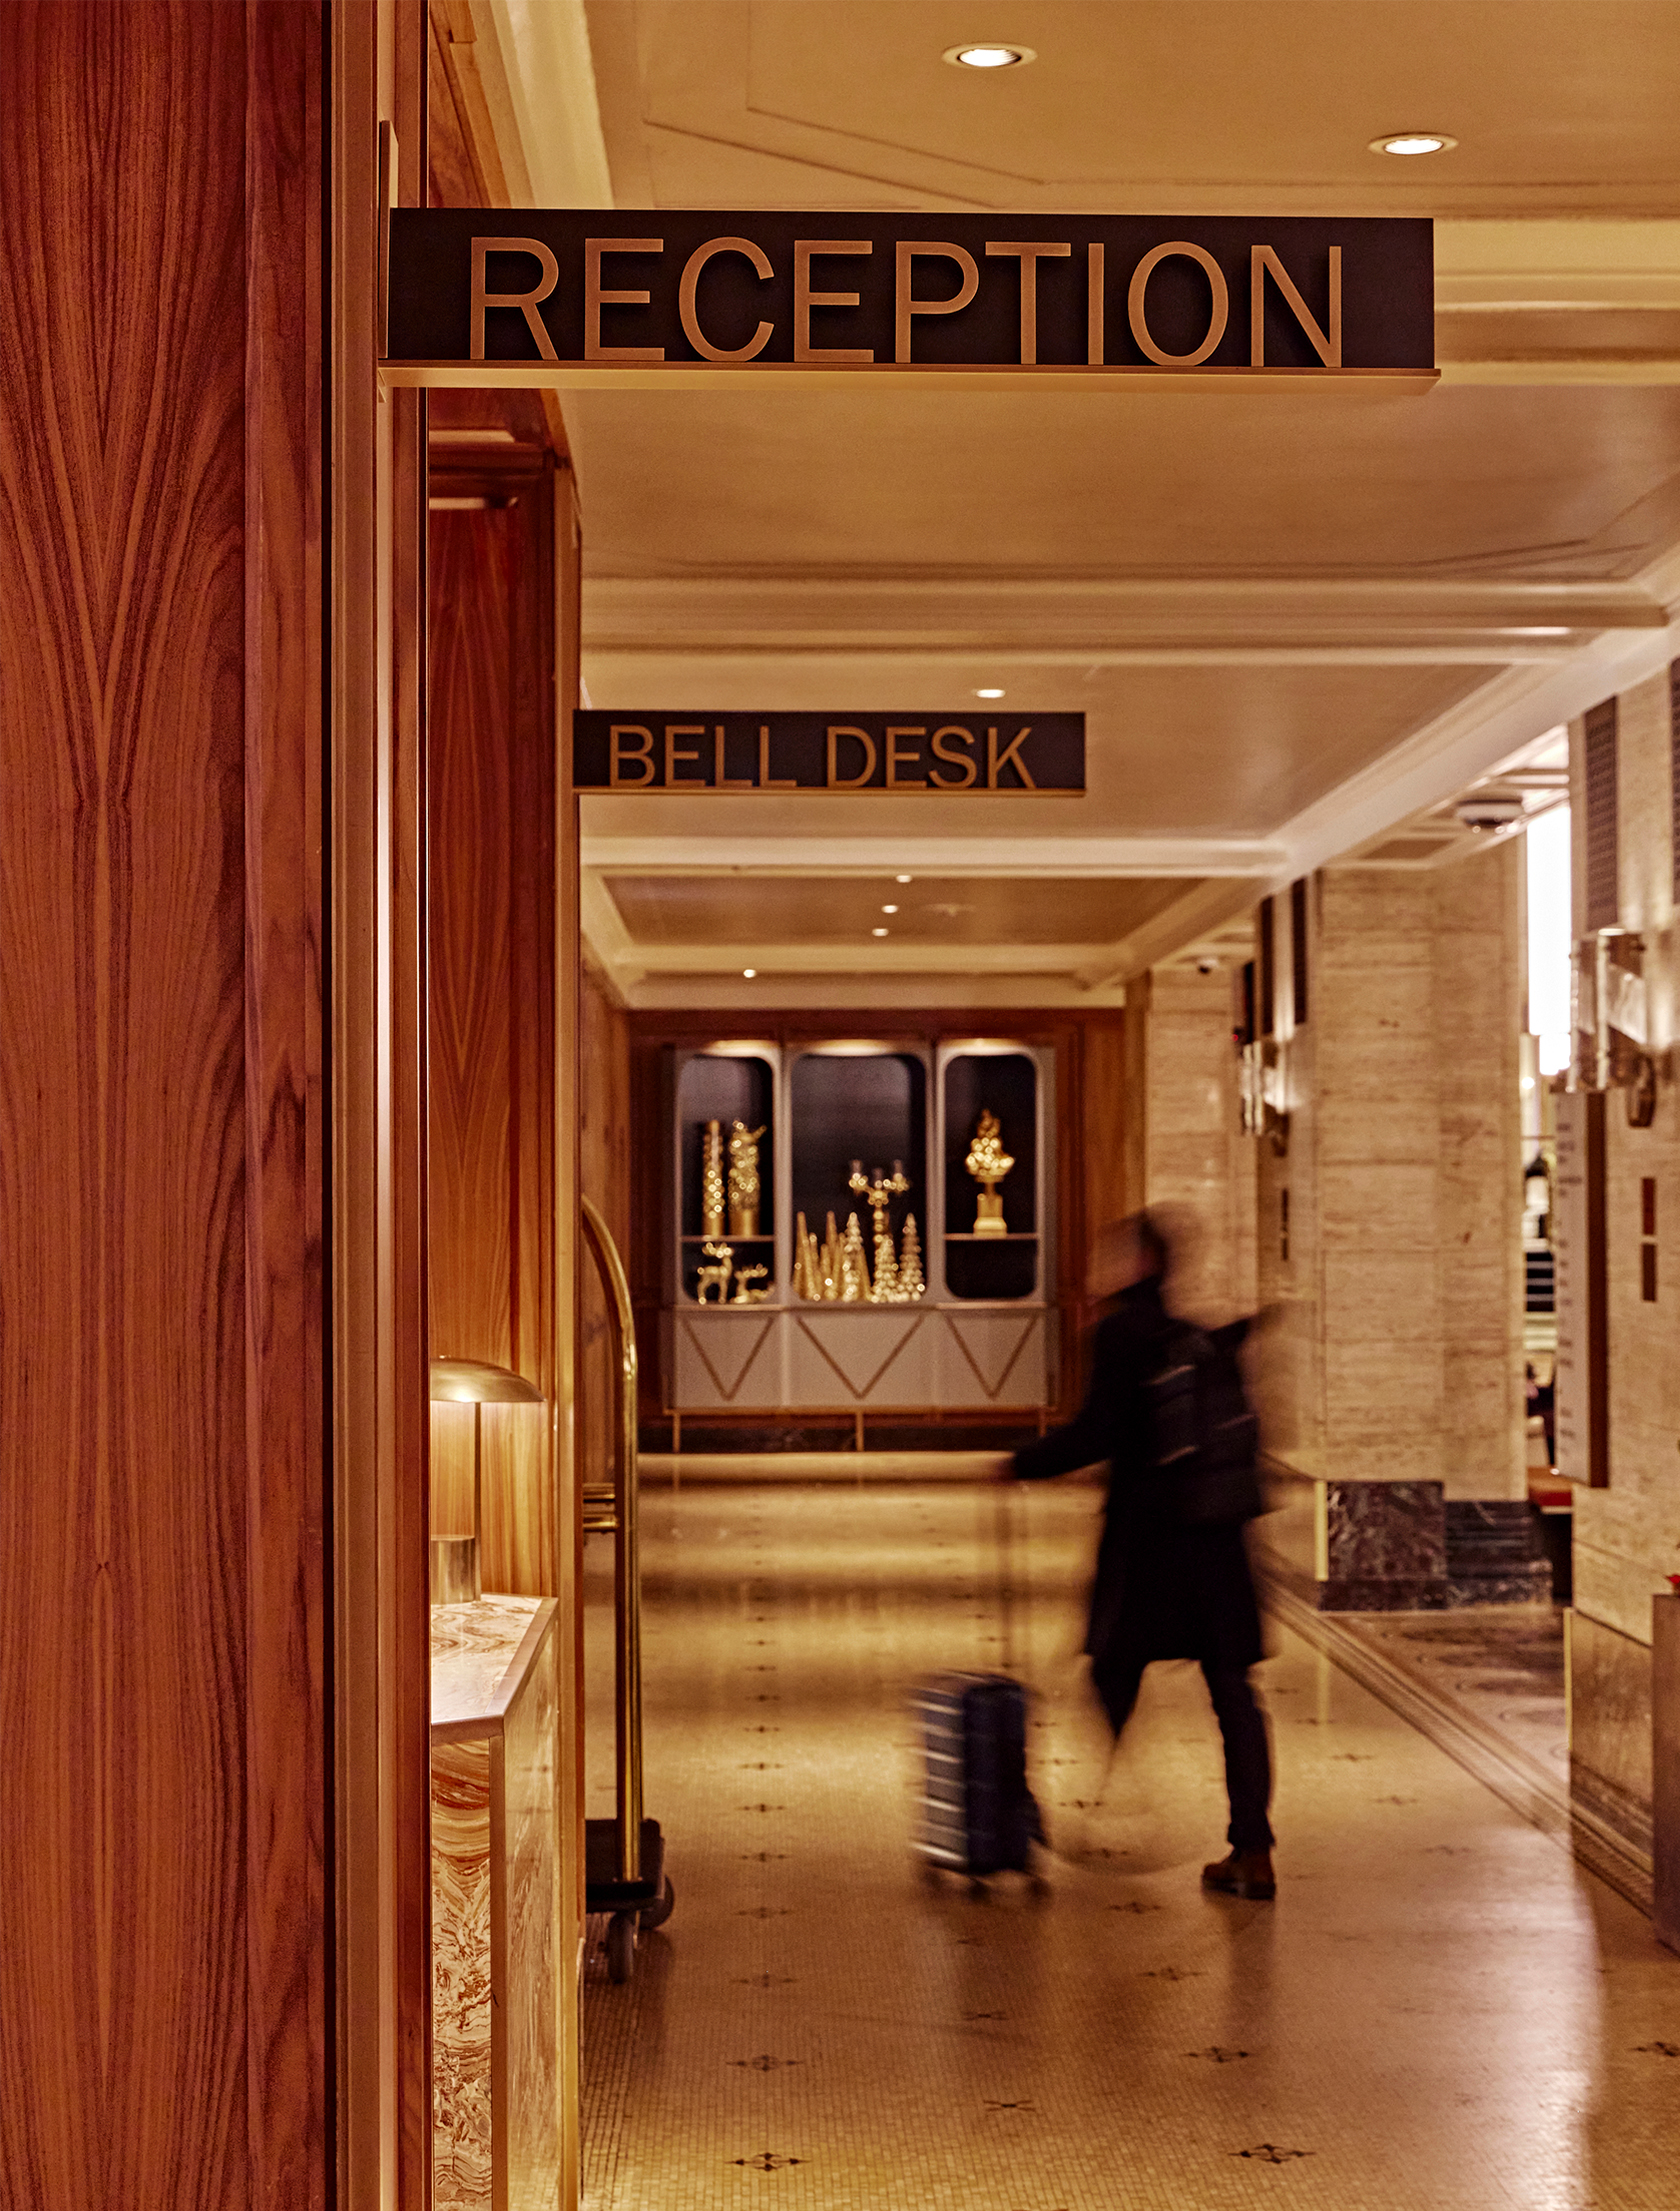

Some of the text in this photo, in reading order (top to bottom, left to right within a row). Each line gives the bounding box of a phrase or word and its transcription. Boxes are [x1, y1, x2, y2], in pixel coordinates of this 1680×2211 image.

[468, 236, 1343, 369] RECEPTION
[609, 724, 1037, 789] BELL DESK
